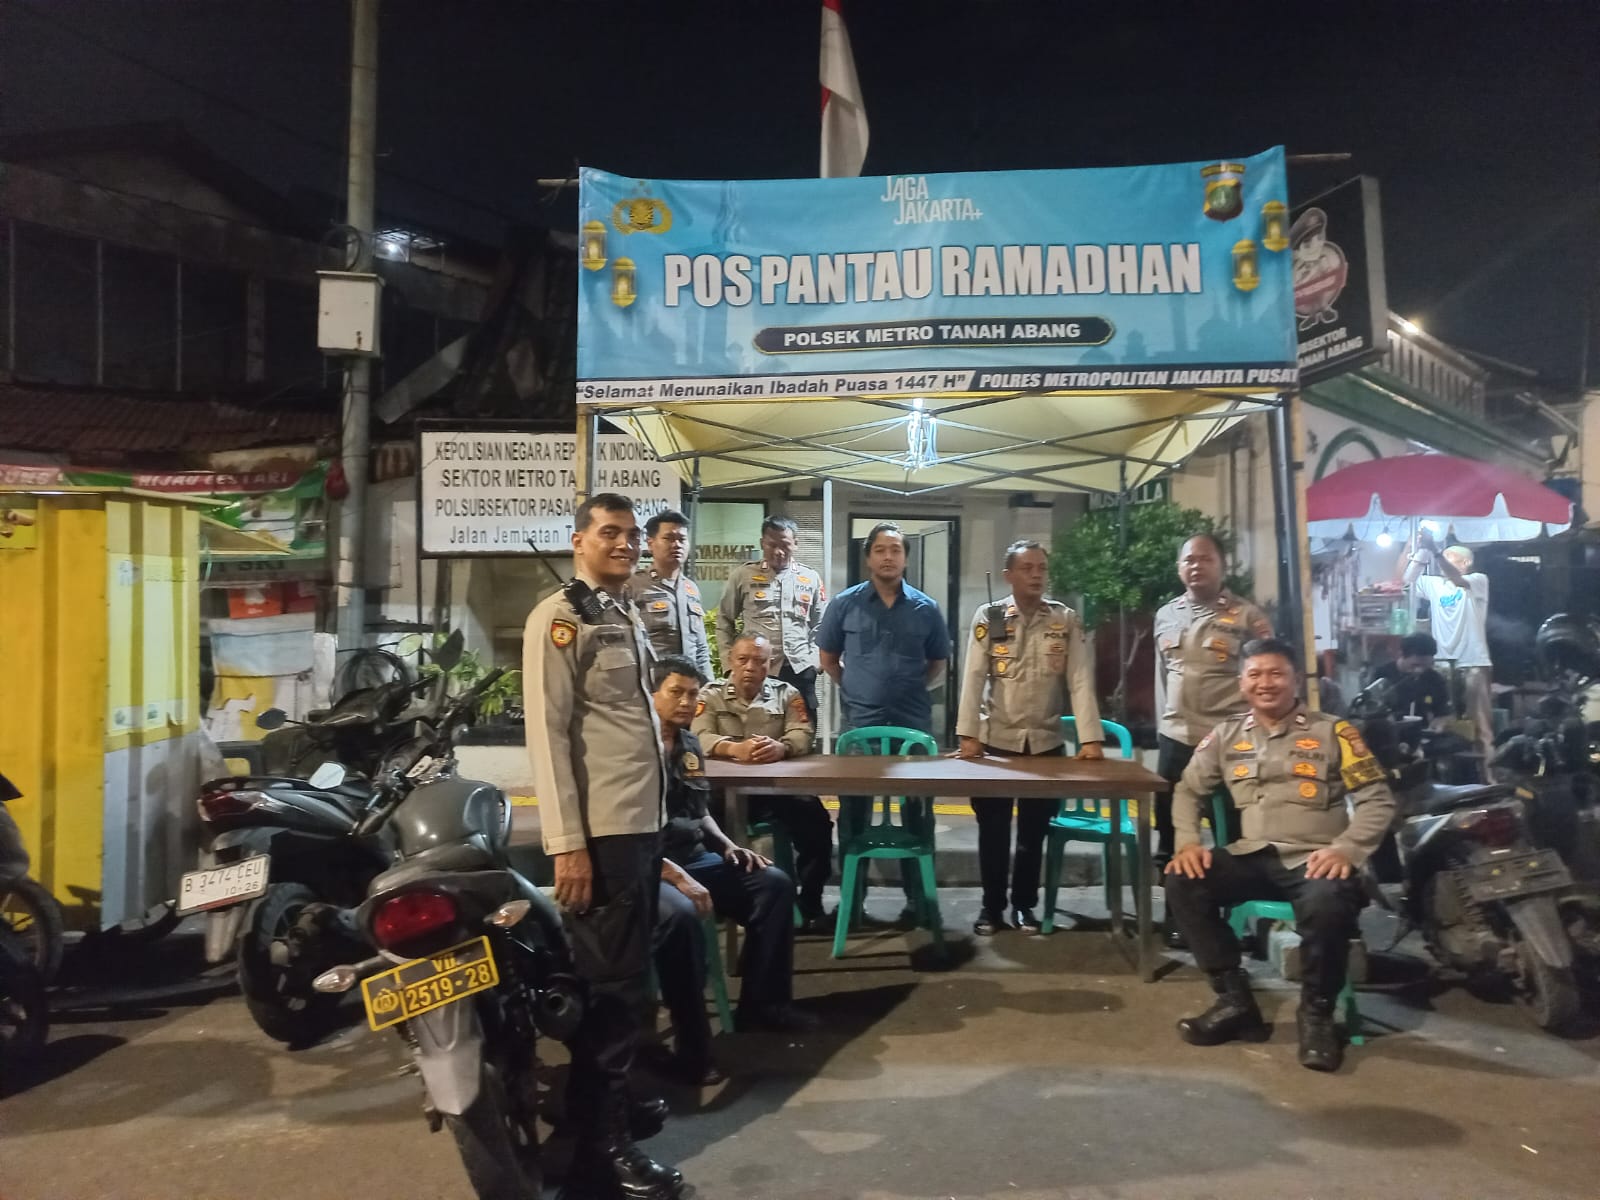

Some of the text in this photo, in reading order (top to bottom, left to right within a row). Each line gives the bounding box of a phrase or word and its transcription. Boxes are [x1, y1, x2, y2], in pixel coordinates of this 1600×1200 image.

[881, 175, 929, 202] JAGA
[664, 242, 1202, 307] POS PANTAU RAMADHAN
[783, 323, 1081, 346] POLSEK METRO TANAH ABANG
[1328, 336, 1363, 359] ABANG
[659, 382, 764, 397] Menunaikan
[769, 379, 829, 394] Ibadah
[835, 377, 888, 392] Puasa
[895, 375, 938, 390] 1447
[979, 373, 1042, 388] POLRES
[1043, 371, 1170, 387] METROPOLITAN
[1169, 369, 1244, 386] JAKARTA
[435, 441, 502, 461] KEPOLISIAN
[505, 441, 551, 461] NEGARA
[442, 469, 661, 488] SEKTOR METRO TAH ABANG
[435, 498, 537, 516] POLSUBSEKTOR
[449, 525, 488, 544] Jalan
[493, 525, 559, 544] Jembatan
[184, 877, 193, 893] B
